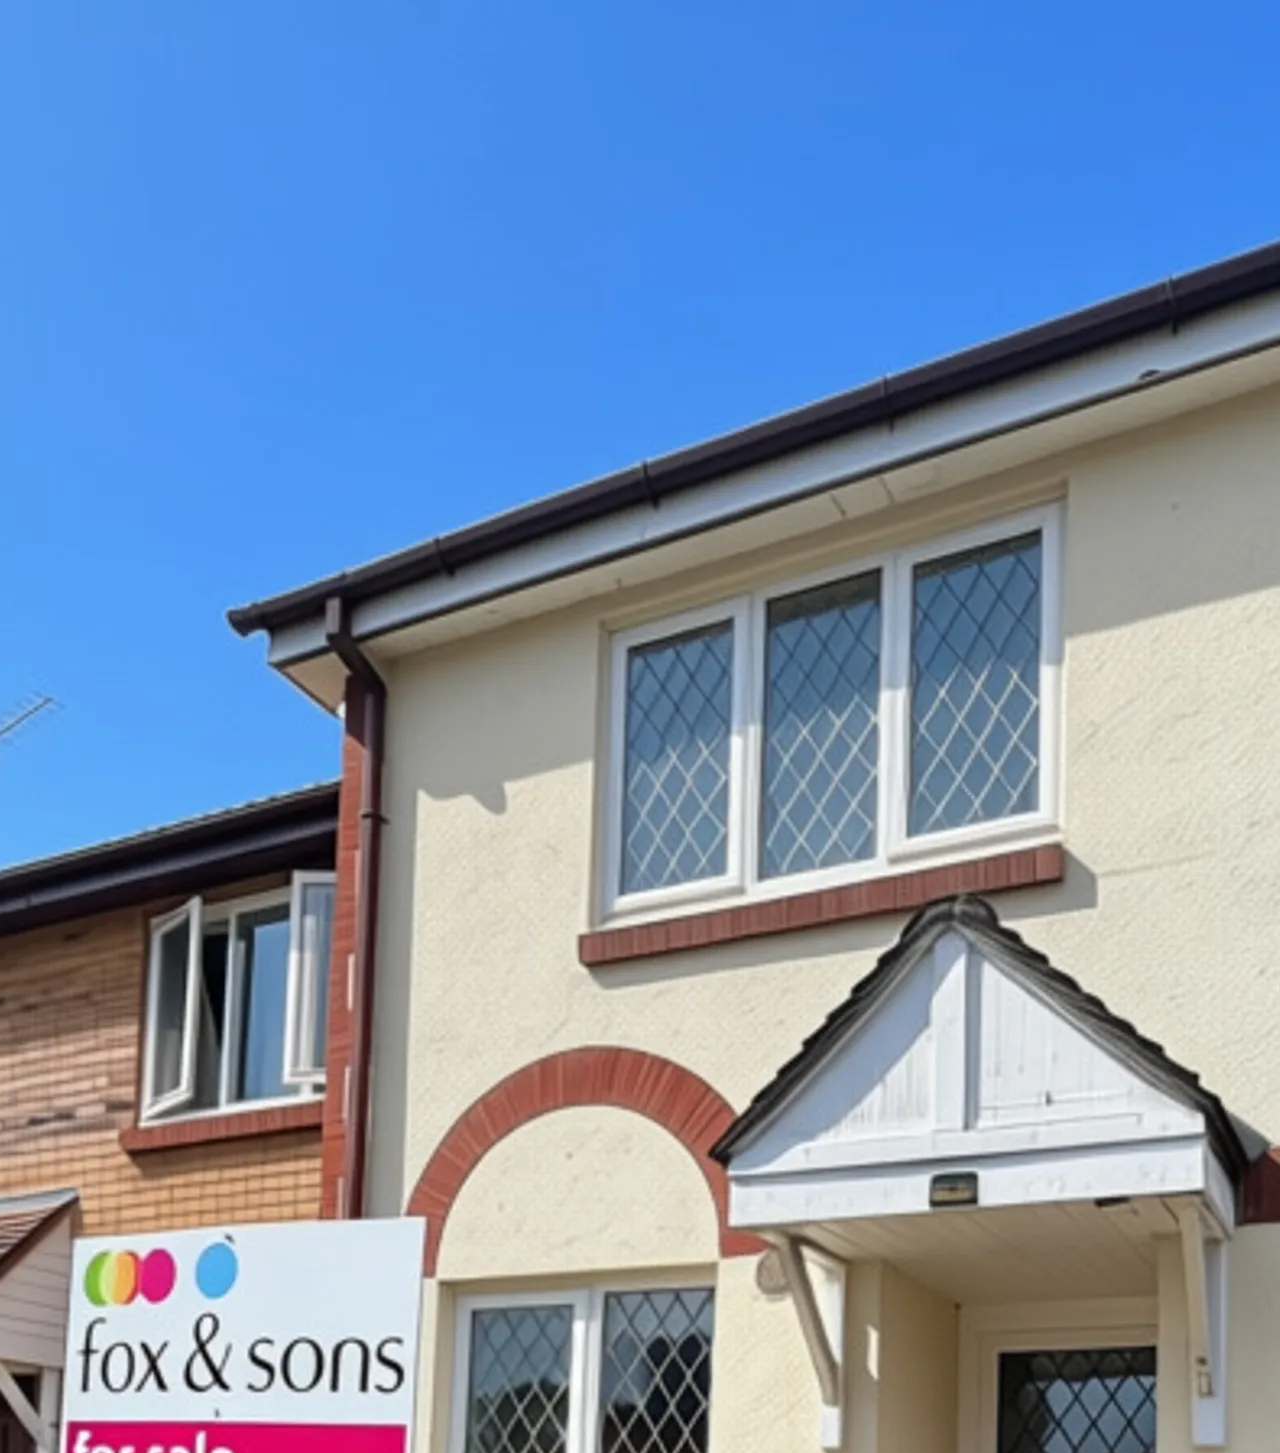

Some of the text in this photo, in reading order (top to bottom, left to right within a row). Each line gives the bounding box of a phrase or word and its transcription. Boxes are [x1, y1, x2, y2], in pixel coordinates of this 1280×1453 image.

[77, 1312, 406, 1394] fox & sons
